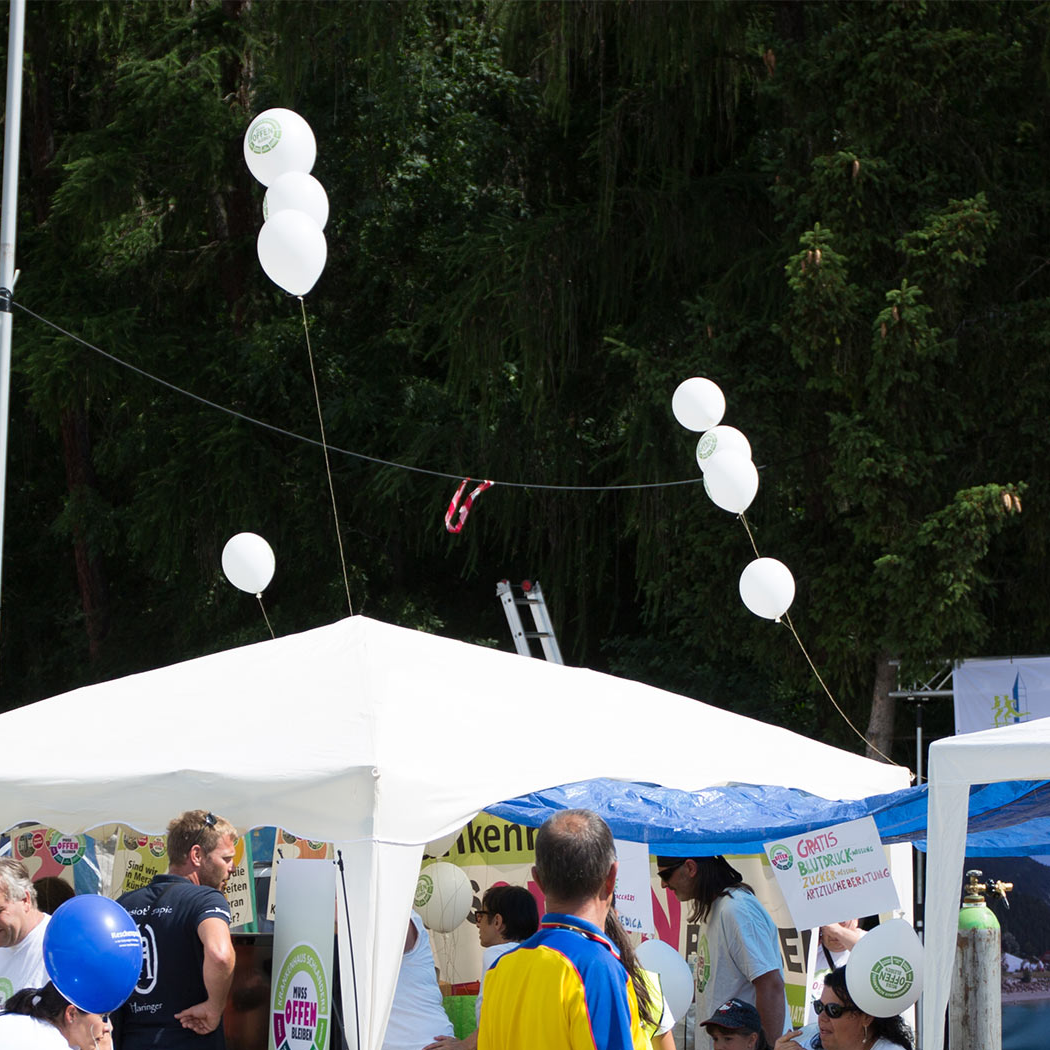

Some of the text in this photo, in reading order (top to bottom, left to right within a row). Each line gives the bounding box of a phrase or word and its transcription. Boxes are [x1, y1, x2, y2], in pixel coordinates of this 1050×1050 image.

[57, 842, 79, 850] OFFEN
[797, 832, 838, 858] GRATIS
[126, 869, 132, 878] in
[128, 860, 158, 876] Sind wir
[847, 868, 890, 889] BERATUNG
[278, 953, 326, 1013] KRANKENHAUS SCHLANDERS
[878, 971, 906, 986] OFFEN
[293, 986, 308, 1000] MUSS
[285, 999, 317, 1028] OFFEN
[291, 1026, 313, 1041] BLEIBEN
